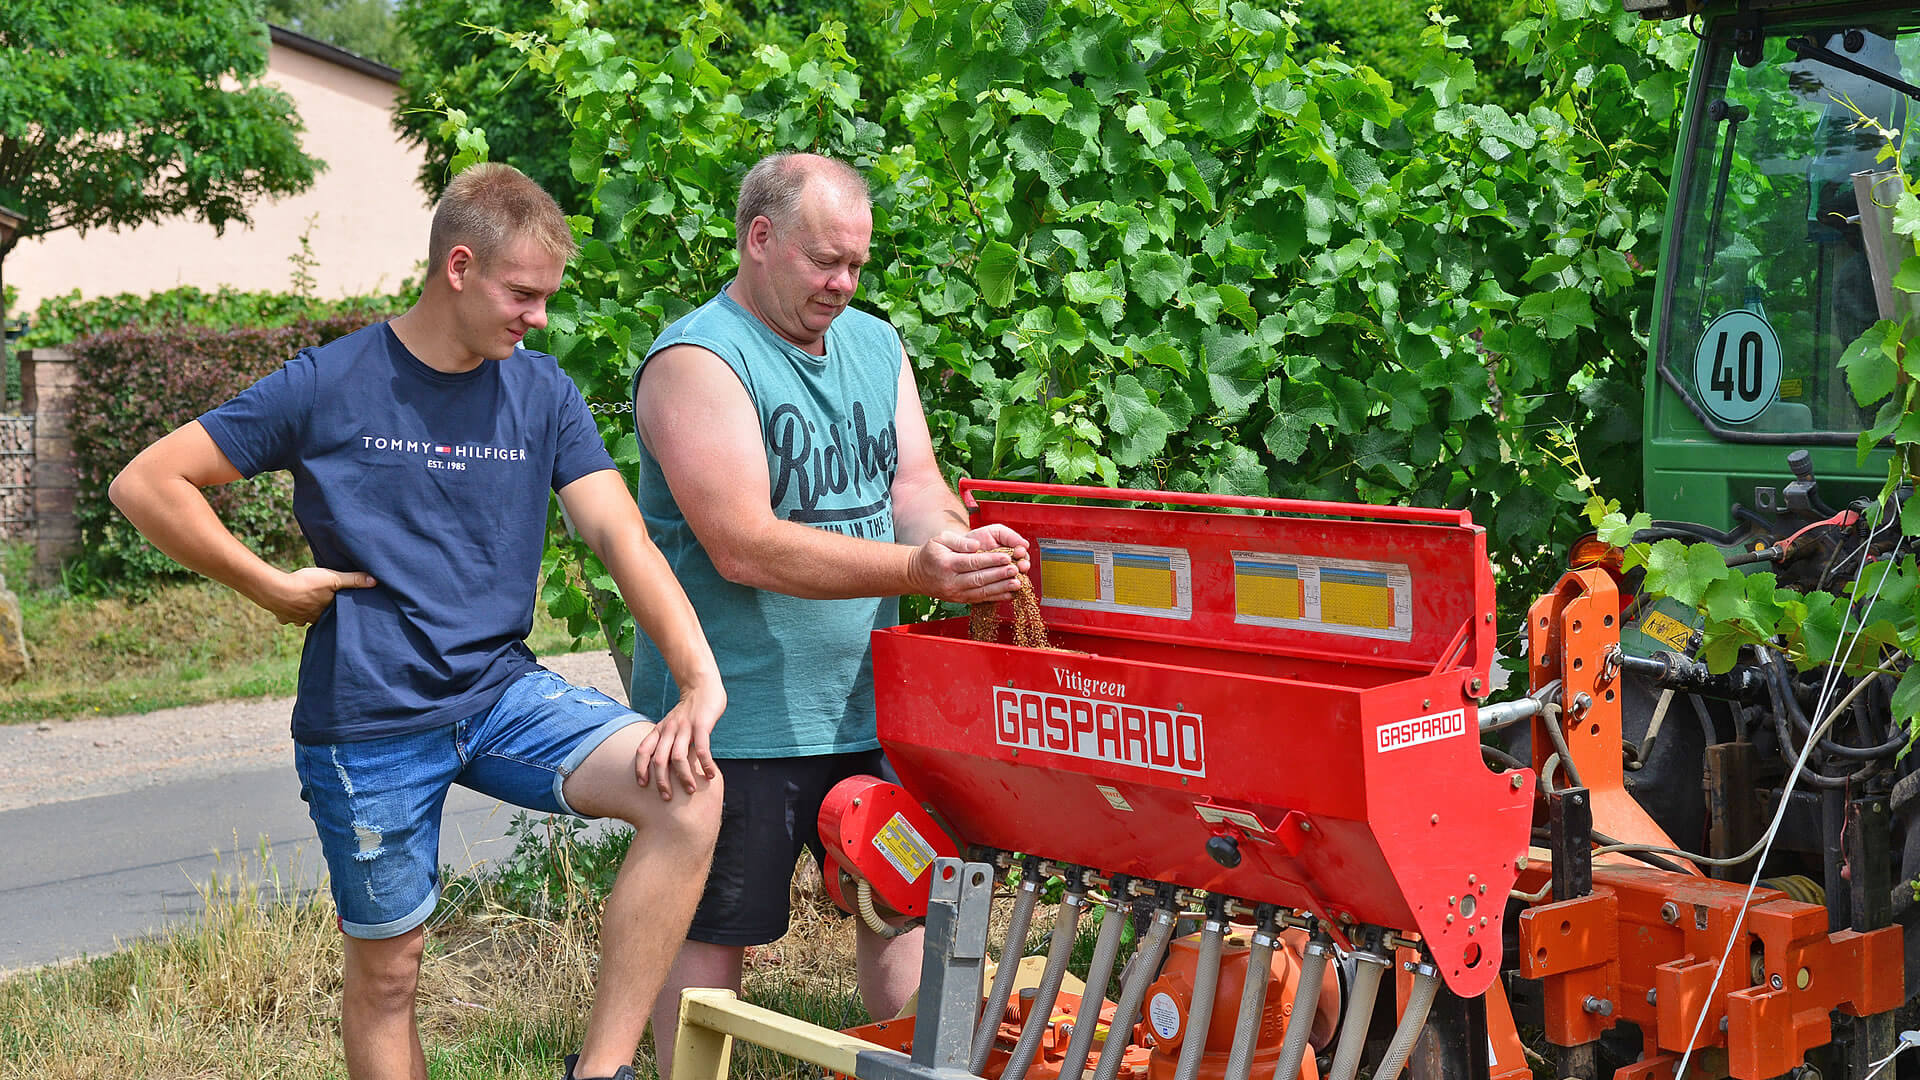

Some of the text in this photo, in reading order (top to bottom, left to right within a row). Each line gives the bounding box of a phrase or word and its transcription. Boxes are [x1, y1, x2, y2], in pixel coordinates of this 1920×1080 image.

[1710, 331, 1763, 402] 40
[362, 436, 526, 461] TOMMY HILFIGER
[427, 459, 466, 471] EST. 1985
[867, 516, 886, 538] THE
[1053, 667, 1127, 698] Vitigreen
[996, 689, 1203, 772] GASPARDO
[1380, 713, 1462, 748] GASPARDO
